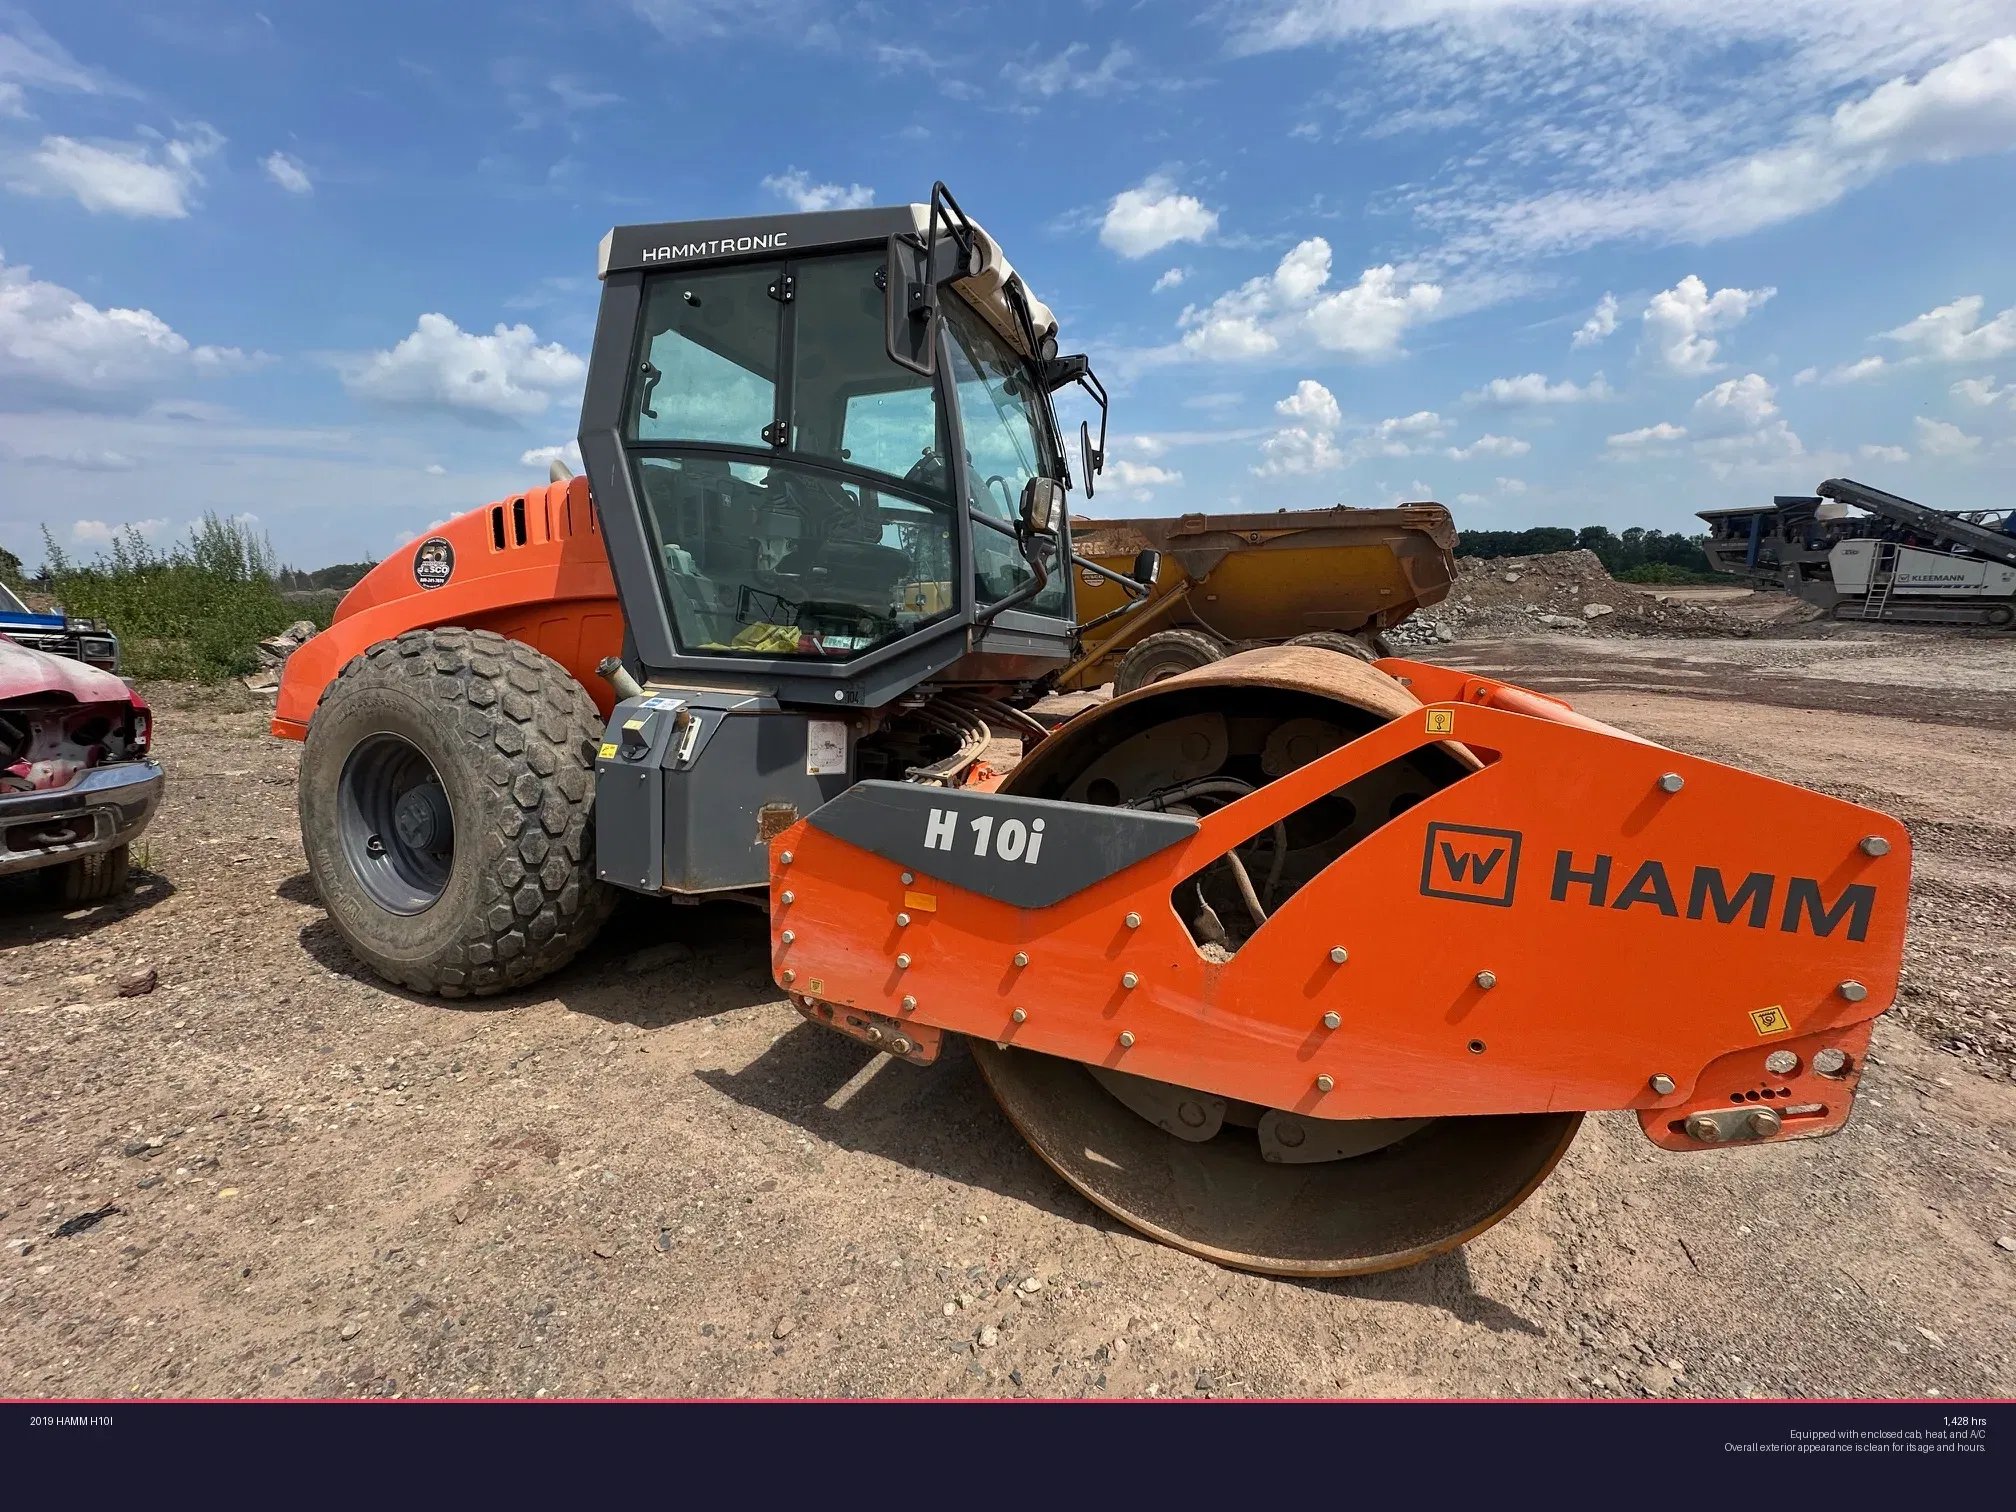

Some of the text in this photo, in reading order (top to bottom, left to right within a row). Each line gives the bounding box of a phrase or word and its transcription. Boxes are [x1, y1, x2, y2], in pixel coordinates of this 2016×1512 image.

[642, 232, 788, 262] HAMMTRONIC
[924, 808, 1046, 865] H 10i
[1550, 849, 1877, 943] HAMM
